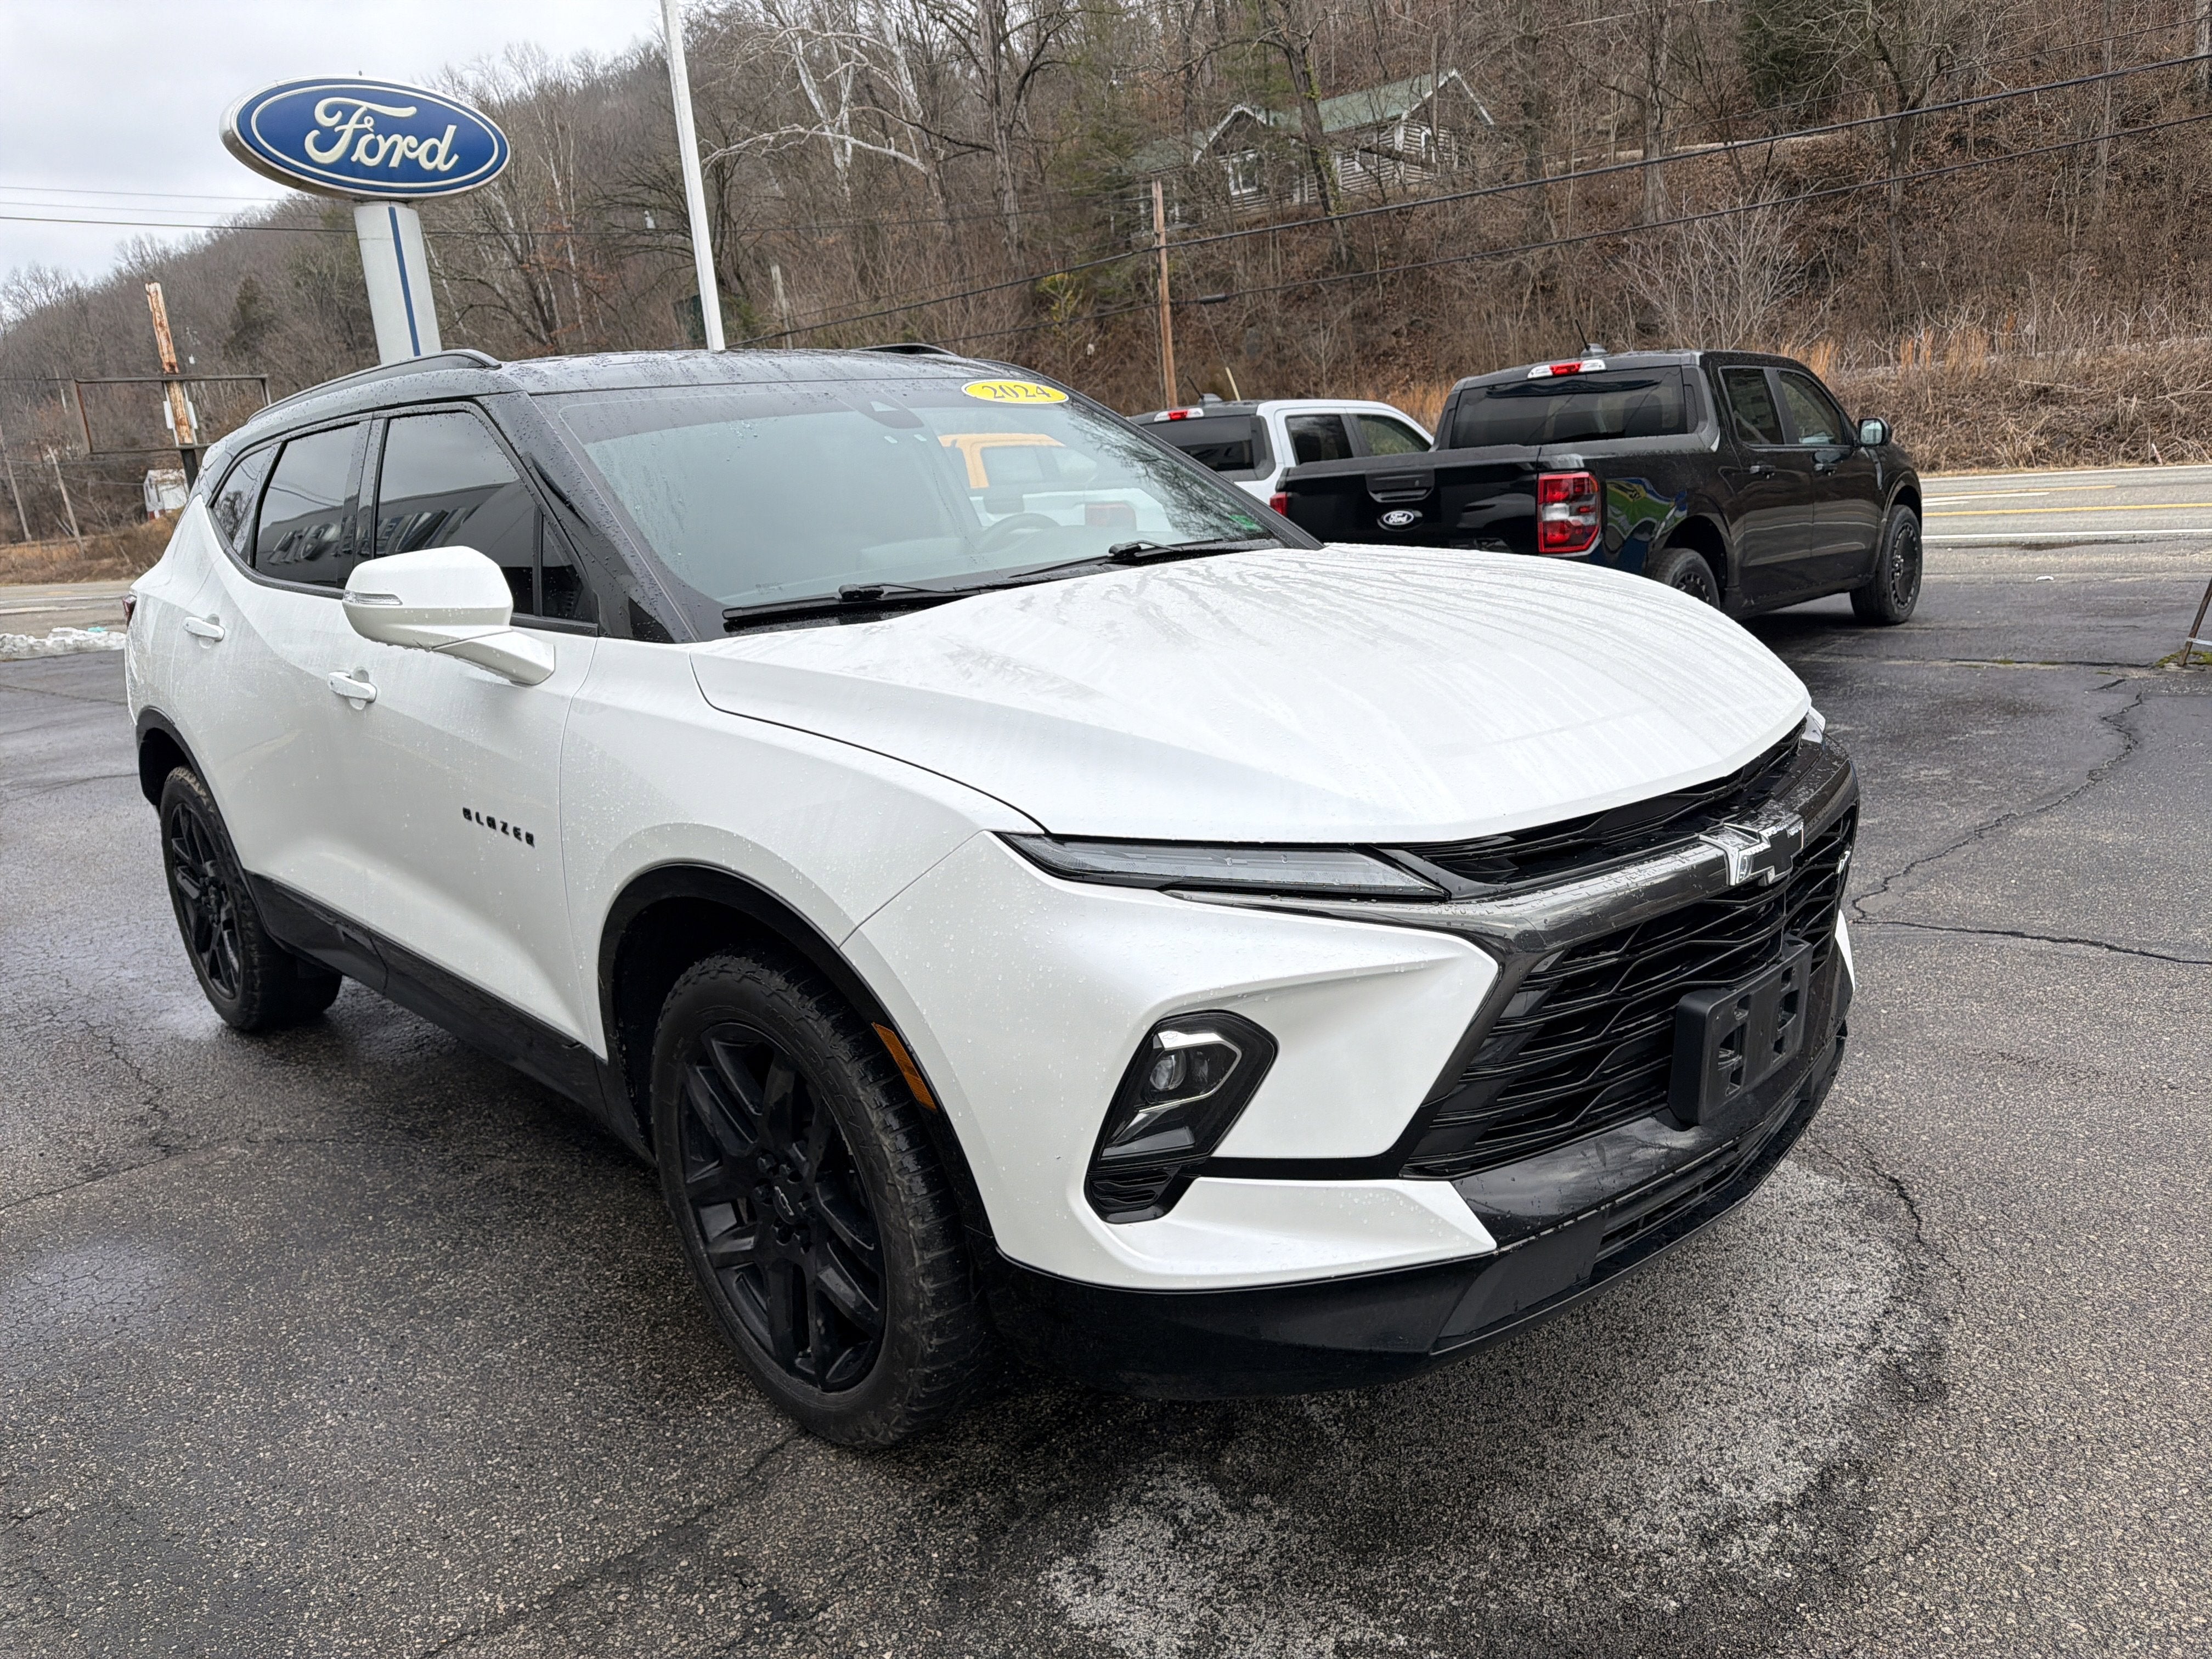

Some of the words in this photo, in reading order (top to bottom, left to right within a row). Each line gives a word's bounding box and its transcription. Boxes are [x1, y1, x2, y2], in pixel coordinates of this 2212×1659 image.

[304, 97, 459, 171] Ford
[982, 385, 1051, 399] 2024
[1389, 513, 1408, 523] Ford
[462, 807, 535, 848] BLAZER
